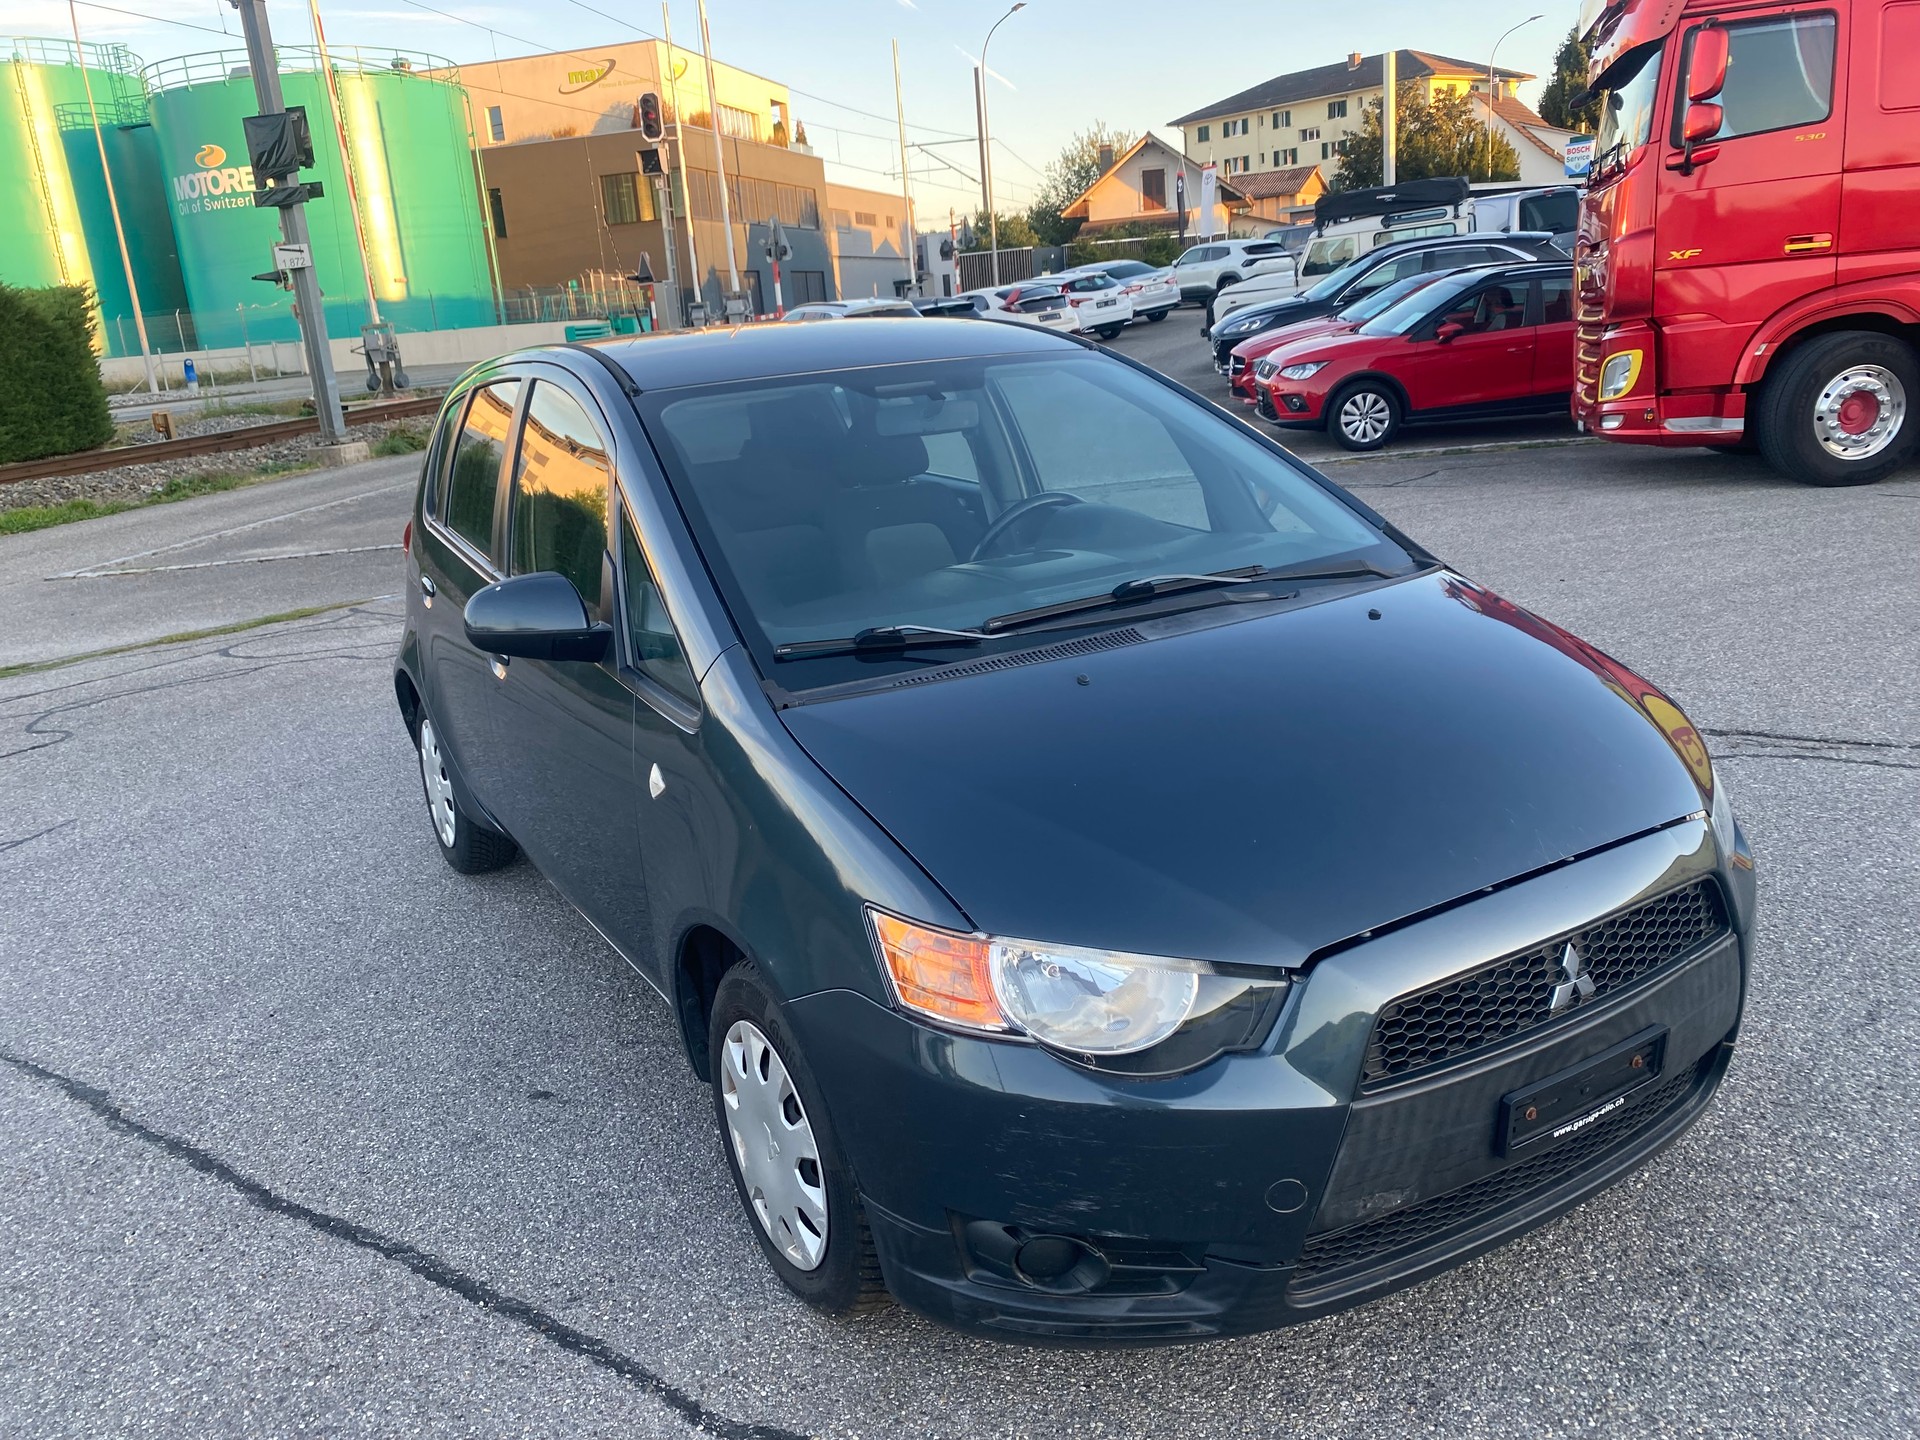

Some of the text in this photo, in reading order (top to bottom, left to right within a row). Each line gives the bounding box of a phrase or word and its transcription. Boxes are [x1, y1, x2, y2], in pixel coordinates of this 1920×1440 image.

[568, 68, 606, 84] max
[1795, 133, 1826, 141] 530
[1566, 145, 1590, 155] BOSCH
[1566, 155, 1590, 163] Service
[173, 166, 257, 201] MOTORE
[179, 194, 256, 216] Oil of Switzerl
[1667, 249, 1702, 260] XF
